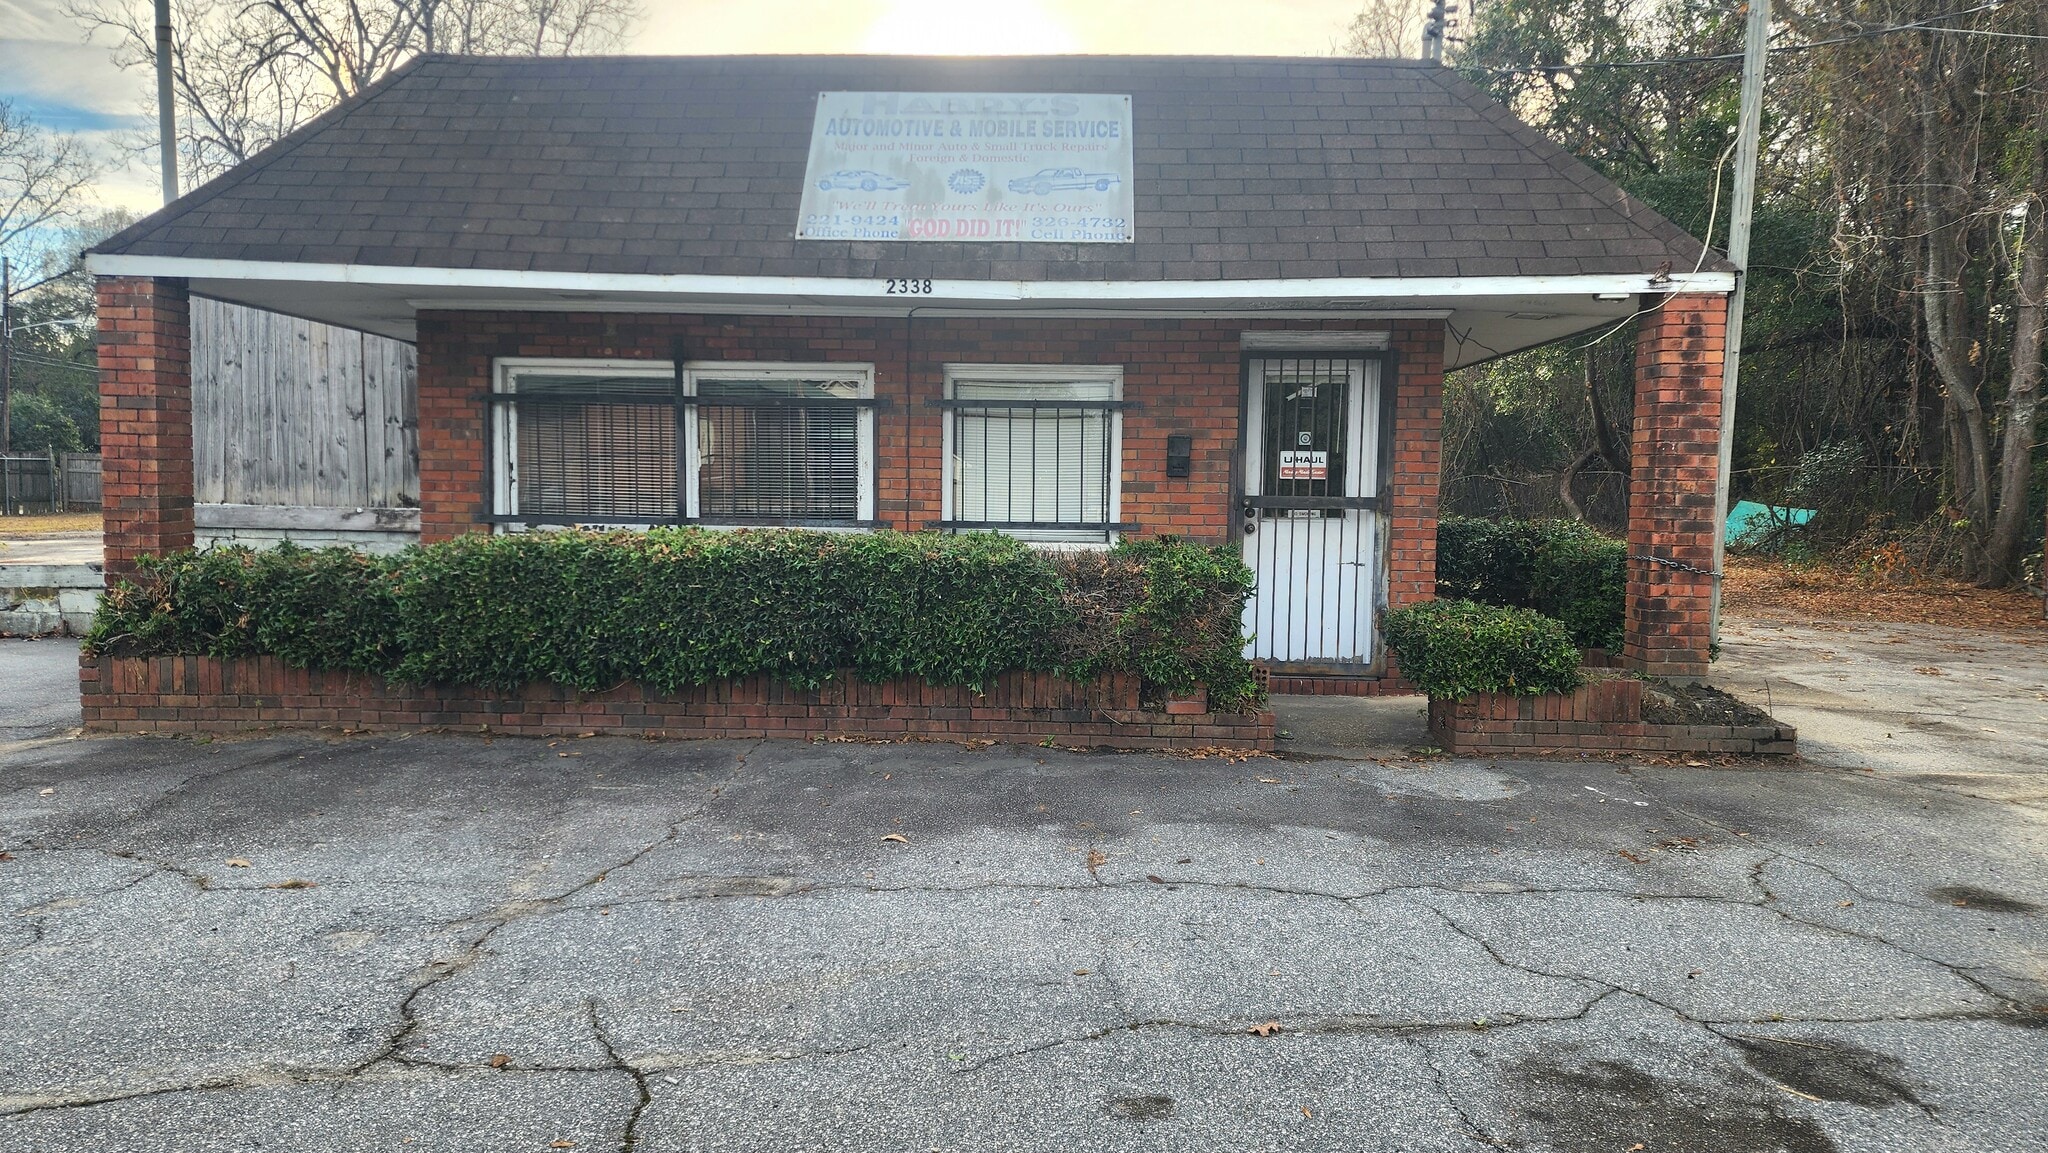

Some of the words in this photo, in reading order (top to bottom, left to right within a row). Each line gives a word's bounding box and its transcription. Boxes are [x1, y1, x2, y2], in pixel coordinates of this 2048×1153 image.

[825, 118, 944, 137] AUTOMOTIVE
[949, 119, 962, 137] &
[968, 119, 1037, 137] MOBILE
[1042, 120, 1120, 138] SERVICE
[834, 142, 868, 152] Major
[872, 142, 895, 151] and
[900, 142, 934, 151] Minor
[938, 142, 967, 151] Auto
[971, 142, 980, 151] &
[985, 142, 1017, 151] Small
[1022, 142, 1057, 151] Truck
[1062, 142, 1108, 153] Repairs
[909, 153, 955, 164] Foreign
[959, 153, 968, 163] &
[972, 153, 1030, 163] Domestic
[883, 202, 927, 211] Treat
[931, 202, 977, 212] Yours
[983, 202, 1018, 212] Like
[1024, 202, 1048, 212] It's
[806, 213, 900, 226] 221-9424
[1032, 216, 1127, 228] 326-4732
[805, 227, 848, 238] Office
[853, 227, 899, 238] Phone
[956, 218, 991, 237] DID
[1031, 229, 1064, 240] Cell
[1071, 229, 1126, 241] Phone
[886, 279, 932, 294] 2338
